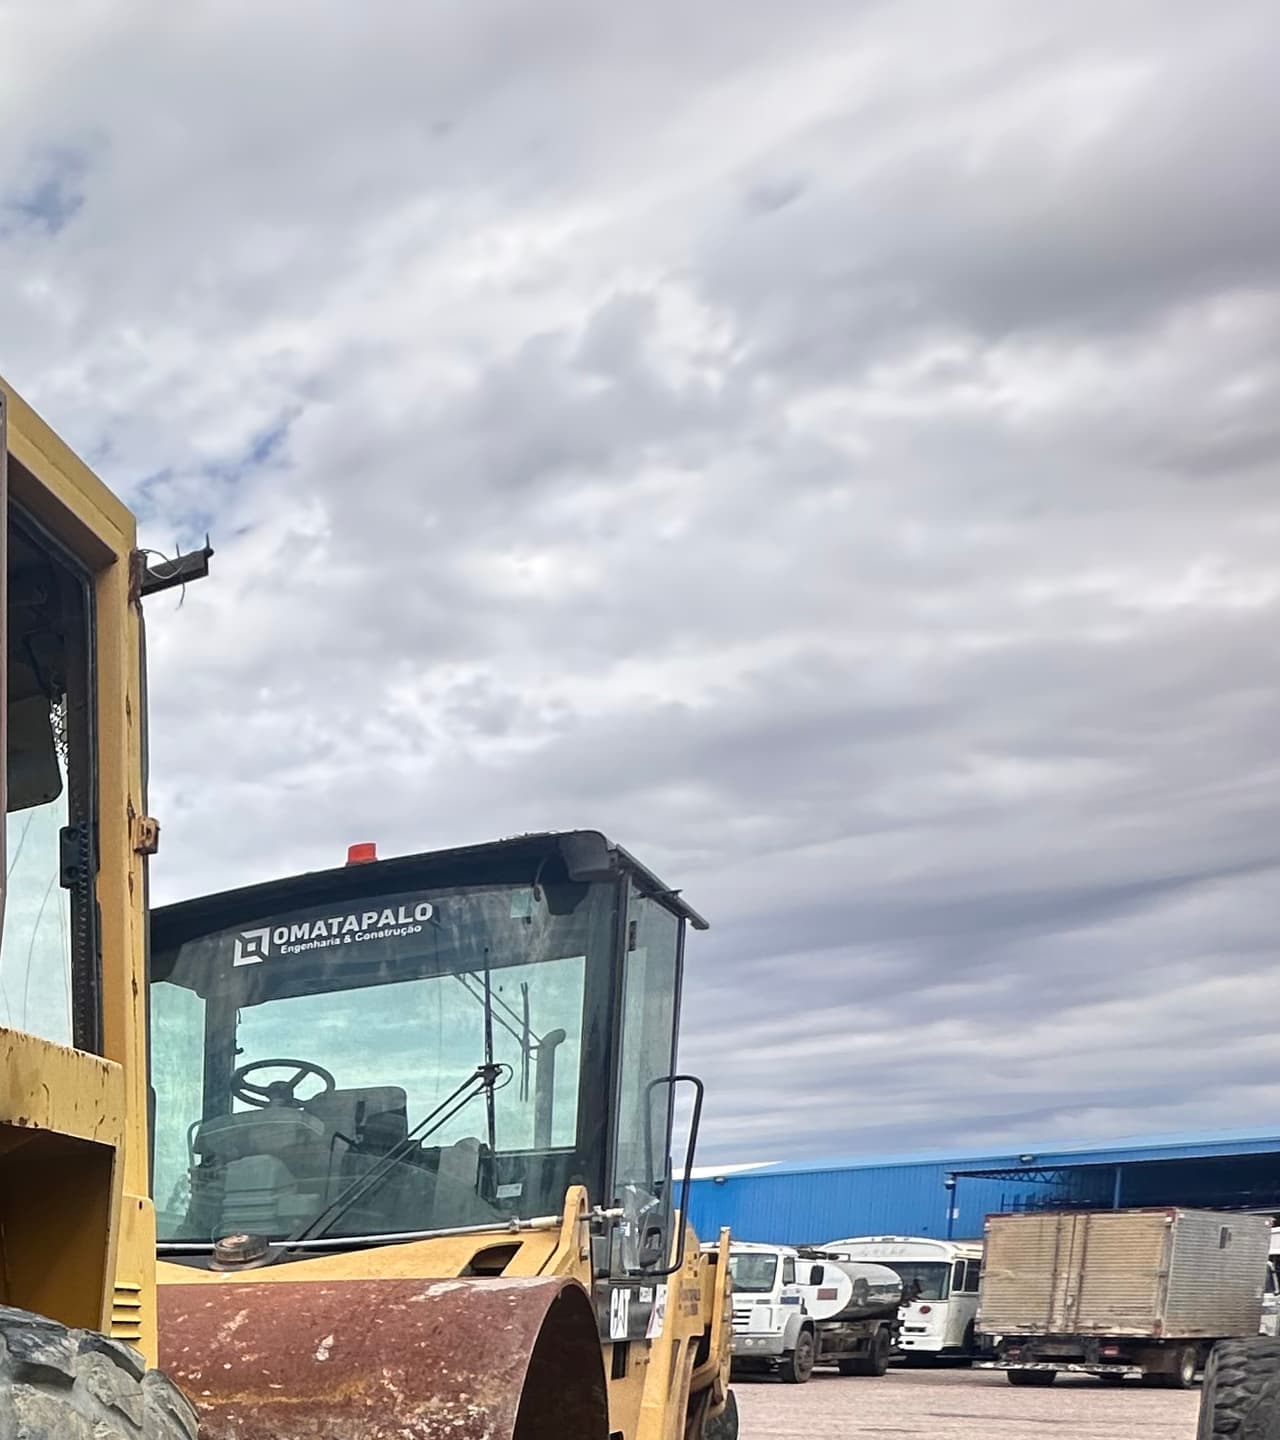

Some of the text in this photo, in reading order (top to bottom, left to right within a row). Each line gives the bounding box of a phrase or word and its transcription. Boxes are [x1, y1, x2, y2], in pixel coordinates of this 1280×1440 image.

[273, 903, 433, 945] OMATAPALO
[280, 924, 422, 955] Engenharia & Construção
[610, 1287, 631, 1339] CAT
